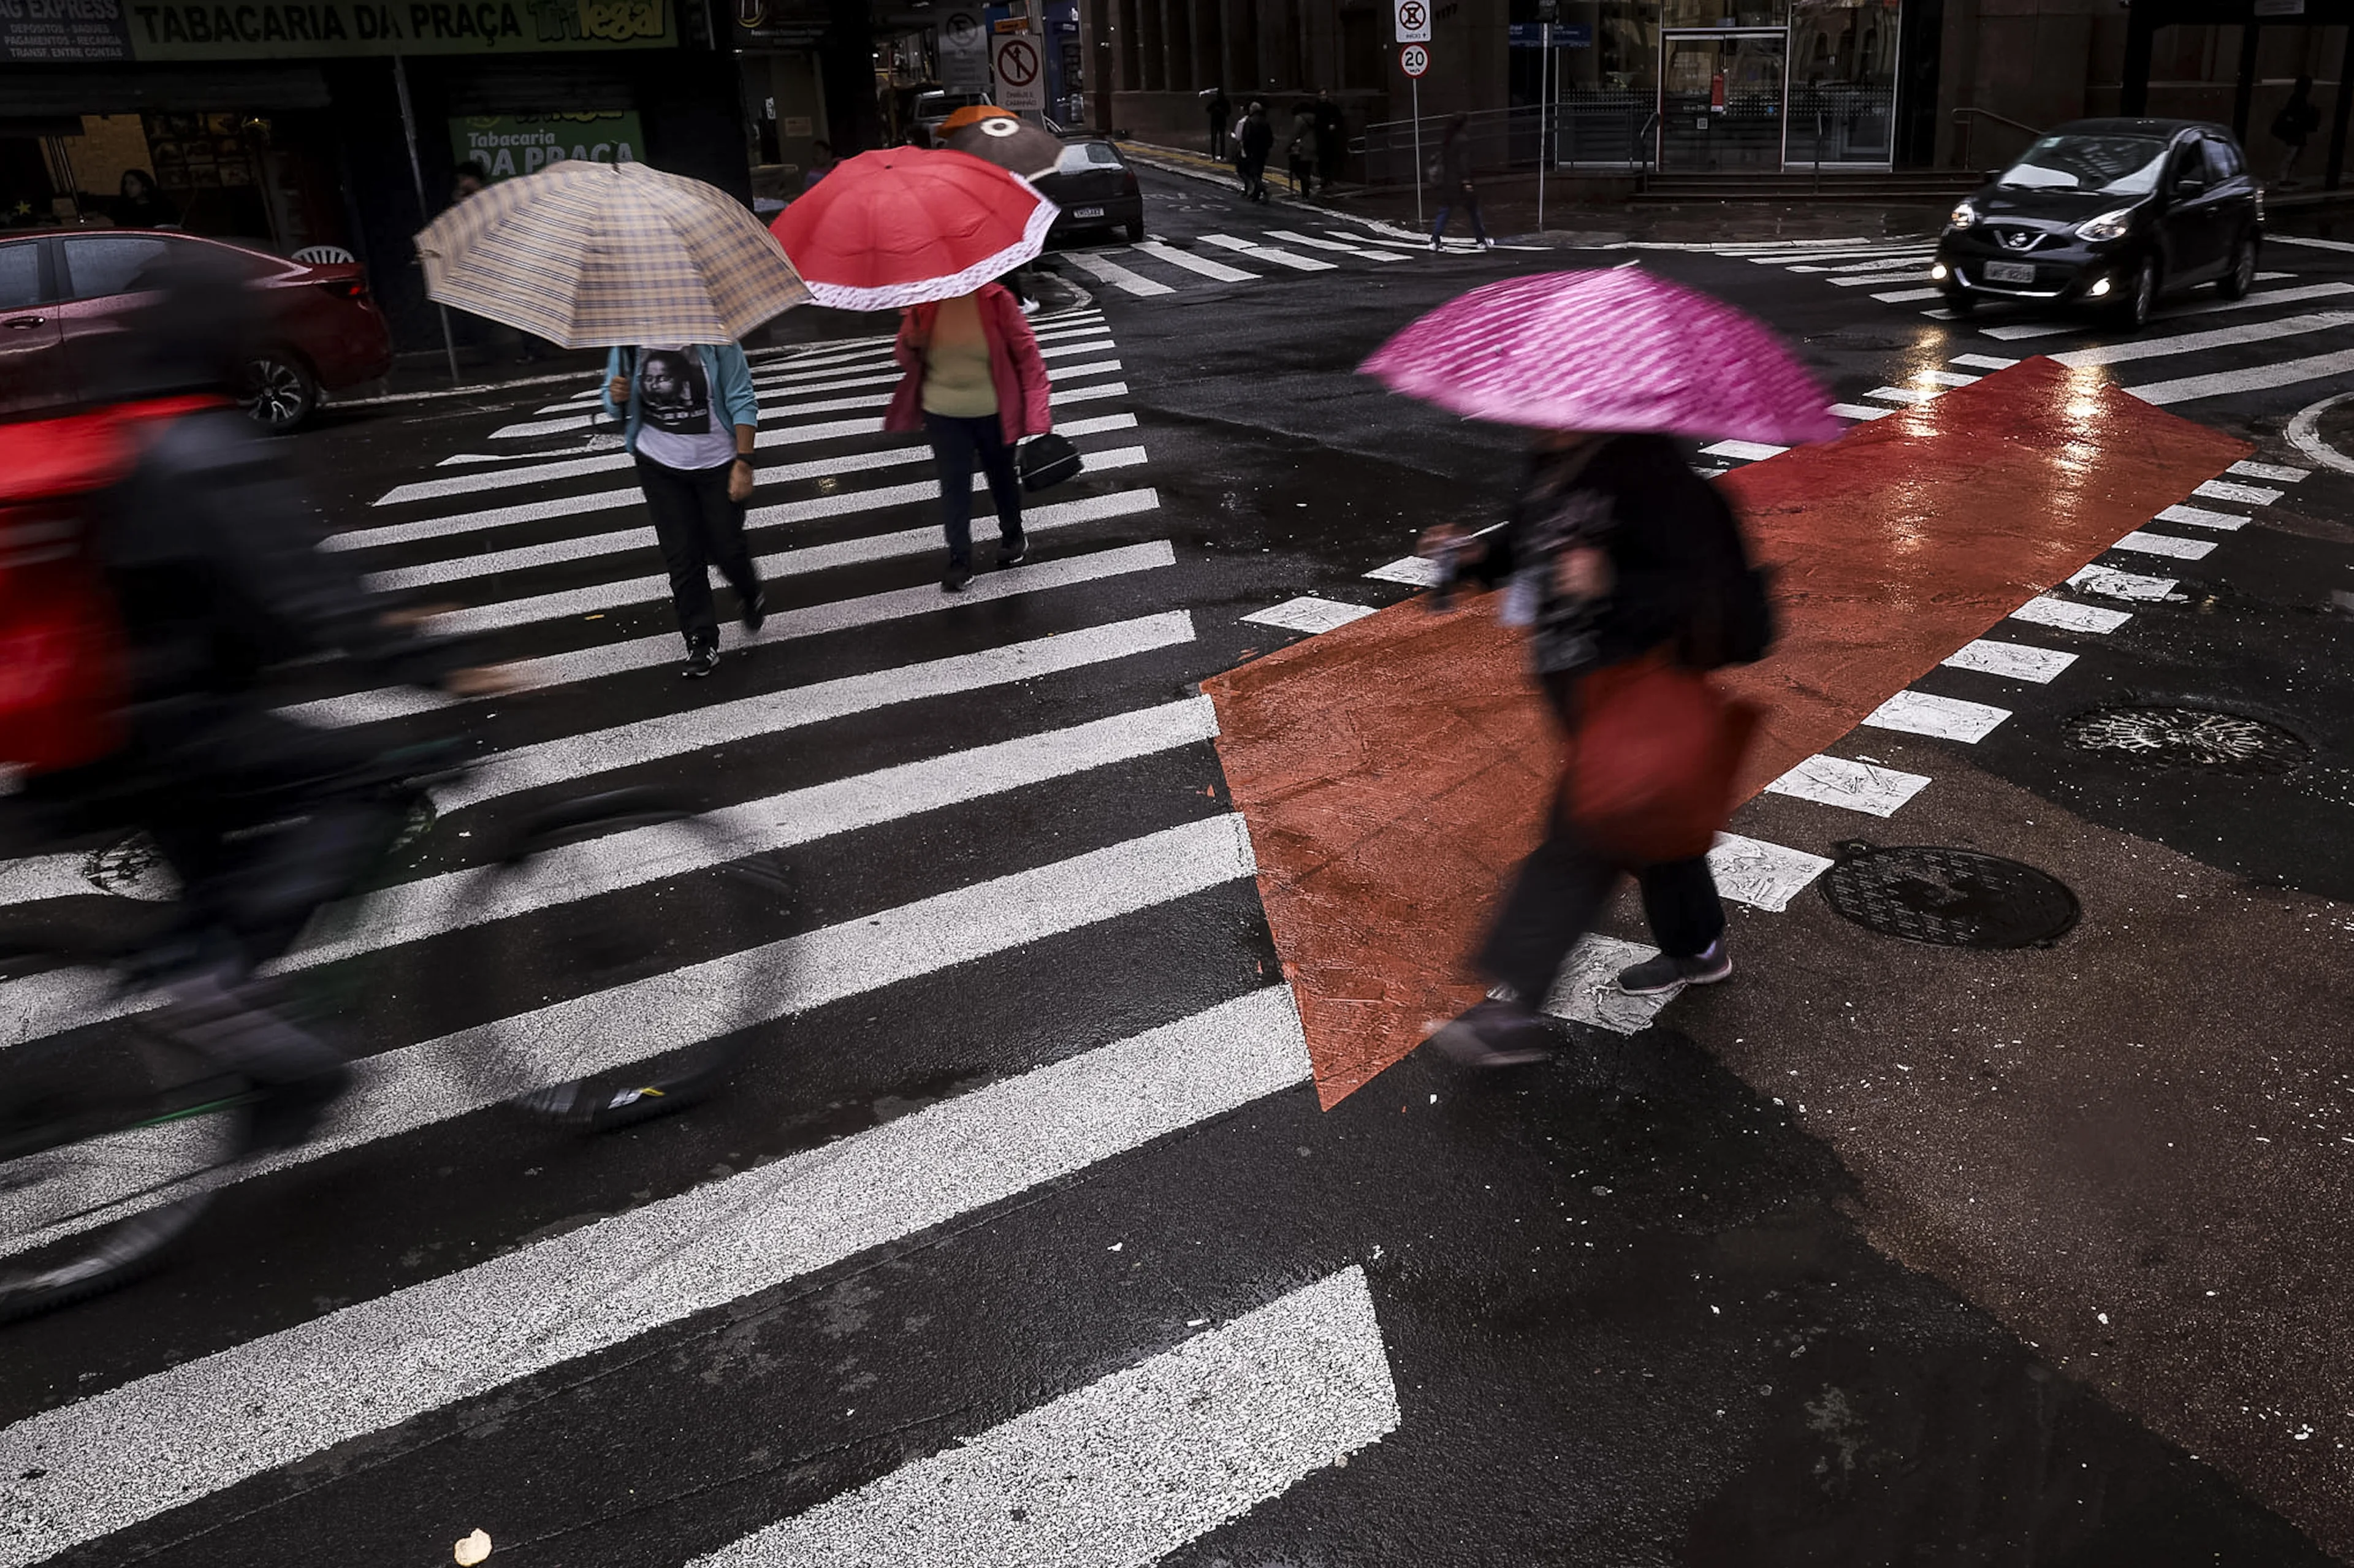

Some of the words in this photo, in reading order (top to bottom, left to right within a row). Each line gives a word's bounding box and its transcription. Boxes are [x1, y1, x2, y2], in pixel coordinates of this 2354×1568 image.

[28, 0, 118, 20] EXPRESS
[134, 5, 348, 43] TABACARIA
[354, 4, 402, 39] DA
[411, 3, 522, 47] PRAÇA
[1406, 51, 1424, 66] 20
[467, 129, 555, 147] Tabacaria
